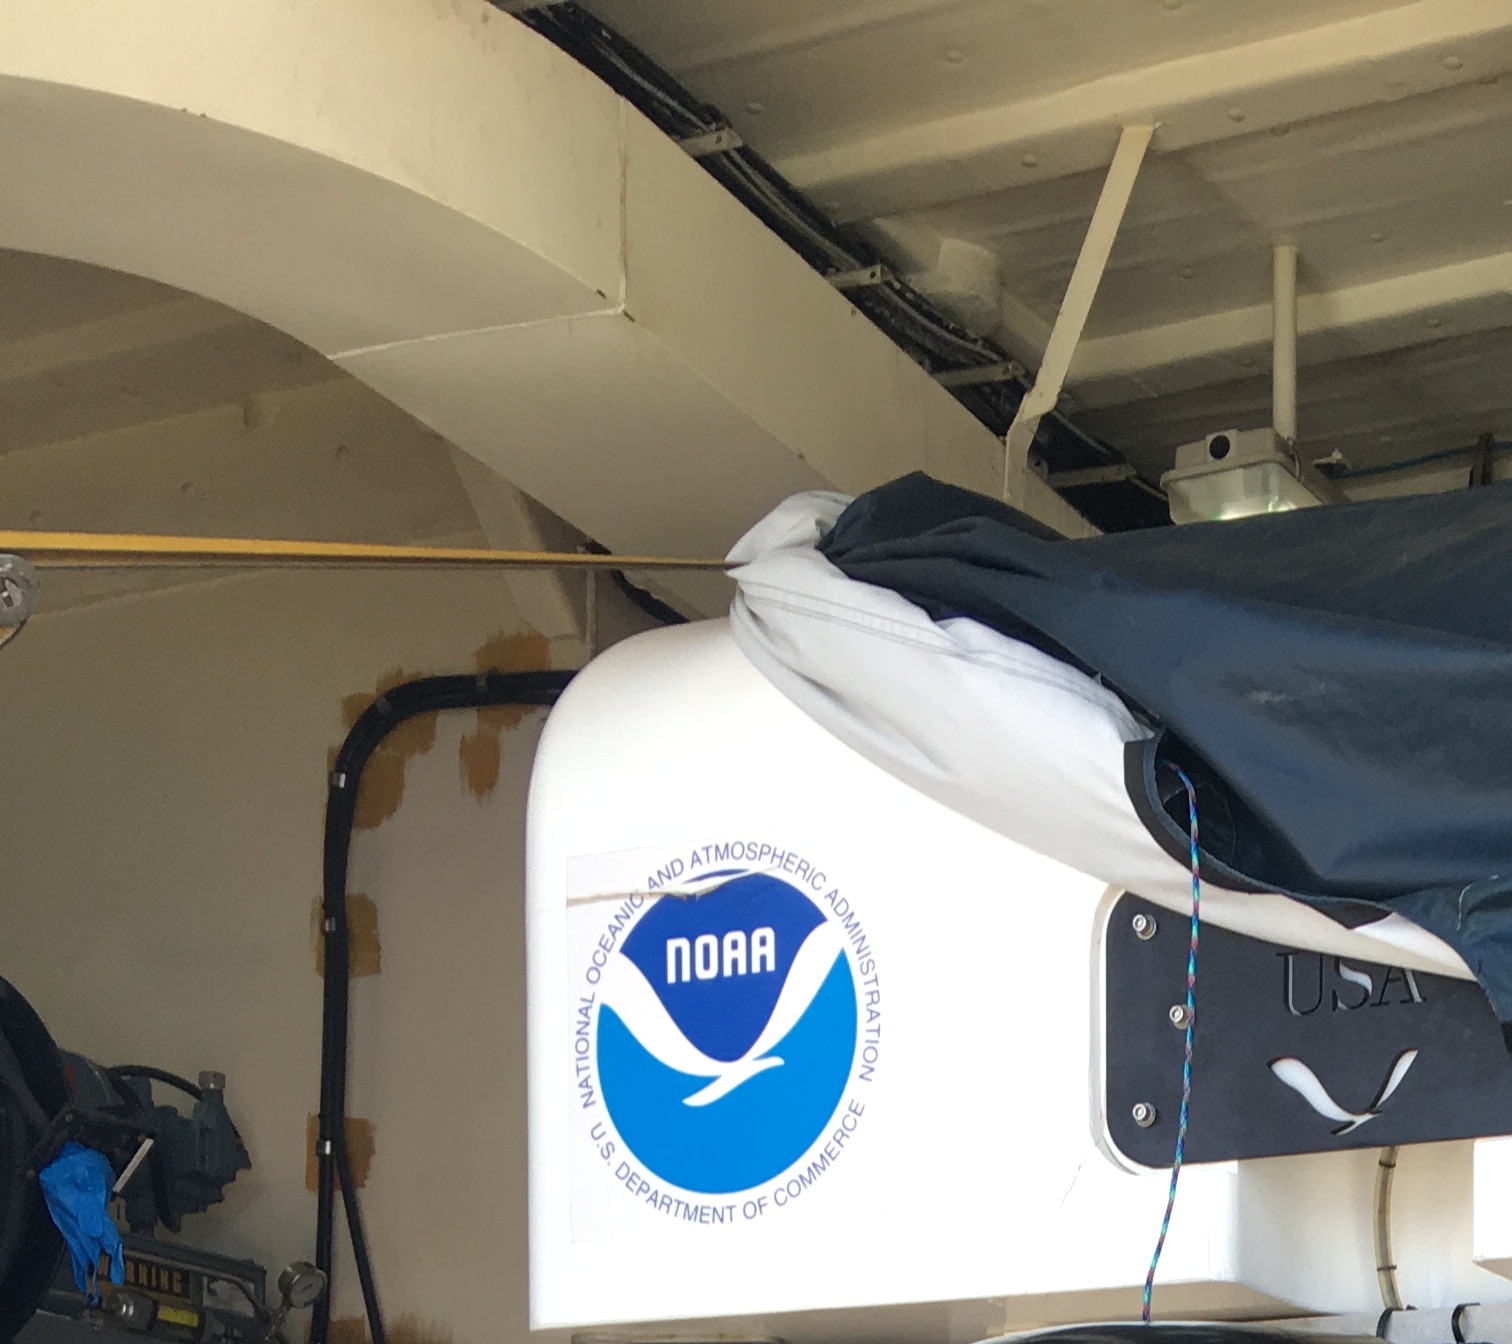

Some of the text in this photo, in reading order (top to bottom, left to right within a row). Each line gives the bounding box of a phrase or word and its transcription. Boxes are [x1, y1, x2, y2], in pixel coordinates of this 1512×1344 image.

[574, 840, 882, 1110] NATIONAL OCEANIC AND ATMOSPHERIC ADMINISTRATION
[666, 926, 776, 985] NOAA
[1275, 951, 1428, 1017] USA
[590, 1098, 866, 1225] U.S. DEPARTMENT OF COMMERCE
[97, 1253, 182, 1294] WRNING
